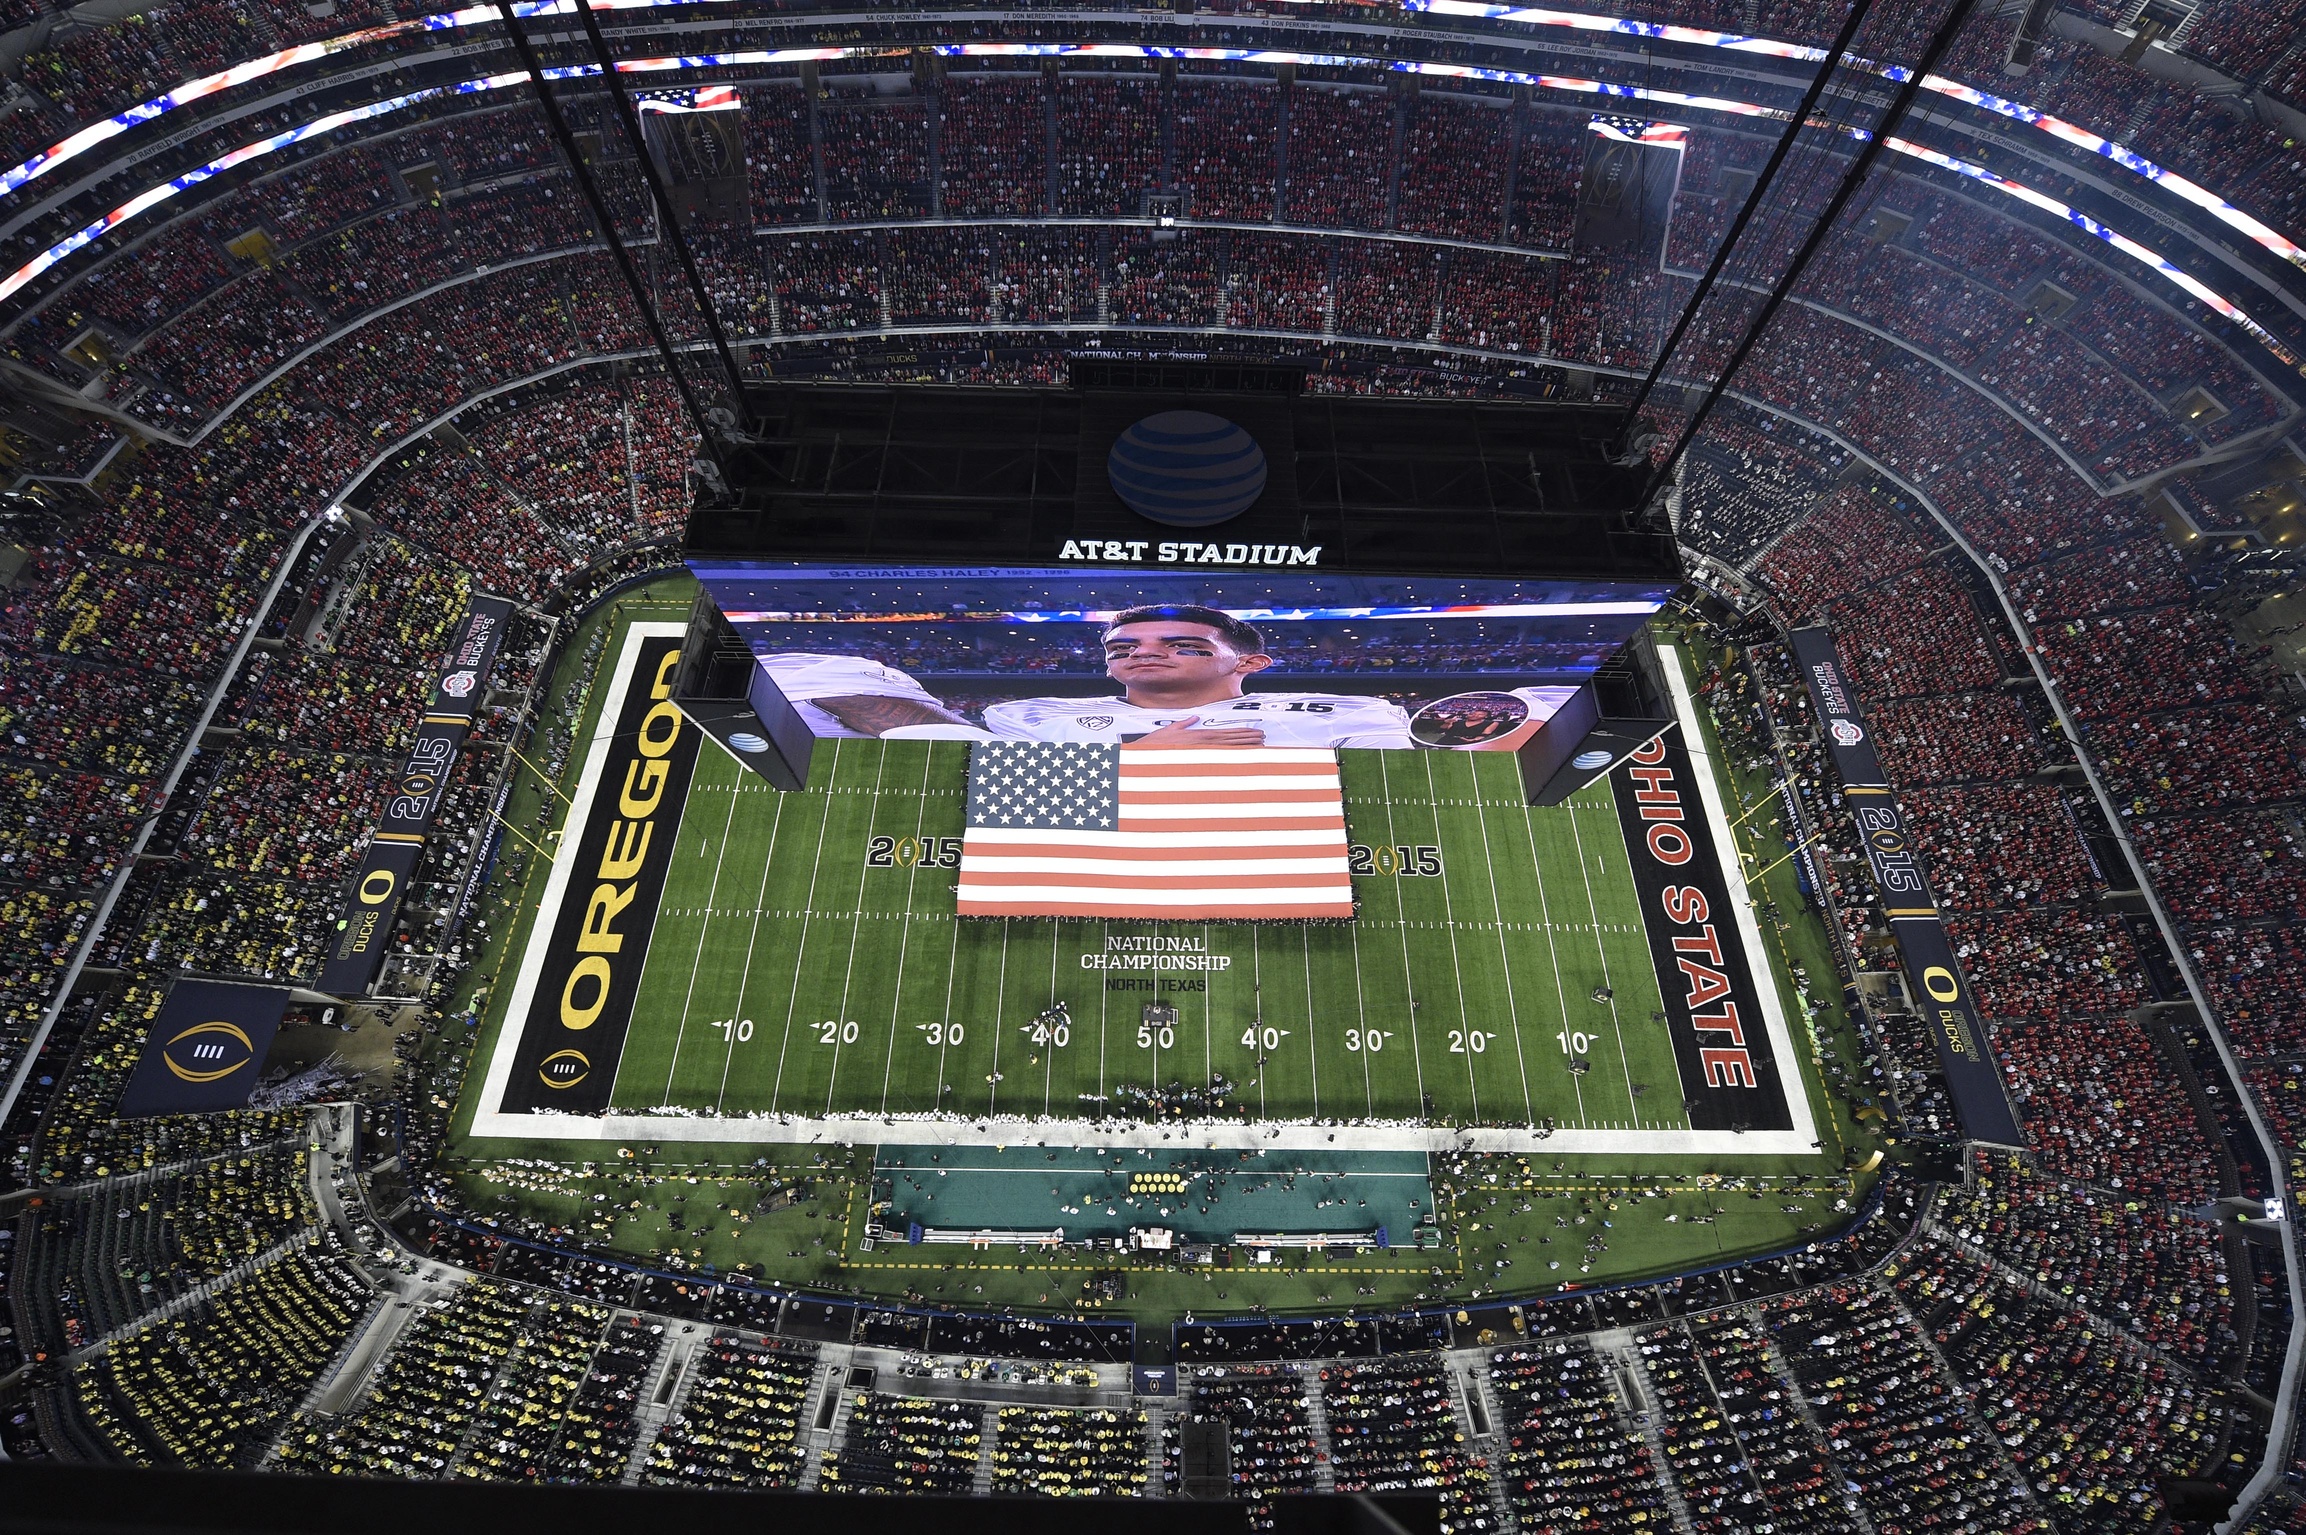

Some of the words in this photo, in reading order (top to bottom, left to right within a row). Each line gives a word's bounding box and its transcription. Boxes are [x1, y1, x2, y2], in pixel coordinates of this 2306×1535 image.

[759, 18, 783, 26] RENFRO
[1285, 21, 1309, 29] PERKINS
[1402, 29, 1422, 37] ROGER
[1423, 31, 1453, 40] STAUBACH
[462, 45, 478, 54] BOB
[1572, 47, 1597, 55] JORDAN
[1693, 63, 1708, 71] TOM
[1709, 66, 1735, 75] LANDRY
[307, 81, 327, 91] CLIFF
[328, 73, 355, 85] HARRIS
[127, 155, 136, 164] 70
[138, 139, 173, 159] RAYFIELD
[172, 127, 201, 143] WRIGHT
[1978, 131, 1992, 140] TEX
[1993, 135, 2027, 154] SCHRAMM
[2112, 189, 2121, 198] 88
[2122, 195, 2144, 210] DREW
[2142, 206, 2176, 227] PEARSON
[886, 354, 917, 363] DUCKS
[1069, 350, 1125, 359] NATIONAL
[1209, 353, 1241, 363] NORTH
[1058, 539, 1149, 561] AT&T
[1158, 542, 1322, 566] STADIUM
[828, 570, 851, 578] 94
[855, 569, 938, 578] CHARLES
[942, 569, 1000, 578] HALEY
[1691, 580, 1718, 599] BUCKEYES
[456, 641, 474, 666] OHIO
[468, 612, 486, 640] STATE
[467, 618, 495, 667] BUCKEYES
[1812, 665, 1839, 715] BUCKEYES
[1822, 661, 1838, 685] OHIO
[1832, 686, 1850, 714] STATE
[430, 787, 443, 813] NATIONAL
[458, 862, 483, 918] NATIONAL
[476, 780, 511, 867] CHAMPIONSHIP
[506, 757, 520, 783] NORTH
[2061, 798, 2078, 834] NATIONAL
[2075, 830, 2101, 880] CHAMPIONSHIP
[1778, 777, 1798, 829] NATIONAL
[1820, 909, 1837, 945] NORTH
[1855, 818, 1867, 844] NATIONAL
[1864, 844, 1881, 884] CHAMPIONSHIP
[359, 869, 395, 905] O
[337, 911, 367, 961] OREGON
[352, 911, 379, 953] DUCKS
[1106, 935, 1206, 953] NATIONAL
[1080, 953, 1231, 972] CHAMPIONSHIP
[1105, 976, 1156, 993] NORTH
[1160, 976, 1207, 993] TEXAS
[1661, 885, 1758, 1089] STATE
[1923, 966, 1959, 1003] O
[722, 1018, 754, 1042] 10
[820, 1021, 859, 1044] 20
[926, 1022, 965, 1046] 30
[1031, 1025, 1070, 1048] 40
[1137, 1026, 1174, 1049] 50
[1241, 1027, 1279, 1050] 40
[1345, 1029, 1383, 1052] 30
[1448, 1030, 1486, 1053] 20
[1928, 1026, 1939, 1047] DUCKS
[1939, 1010, 1964, 1053] DUCKS
[1952, 1010, 1980, 1062] OREGON
[1556, 1031, 1589, 1054] 10
